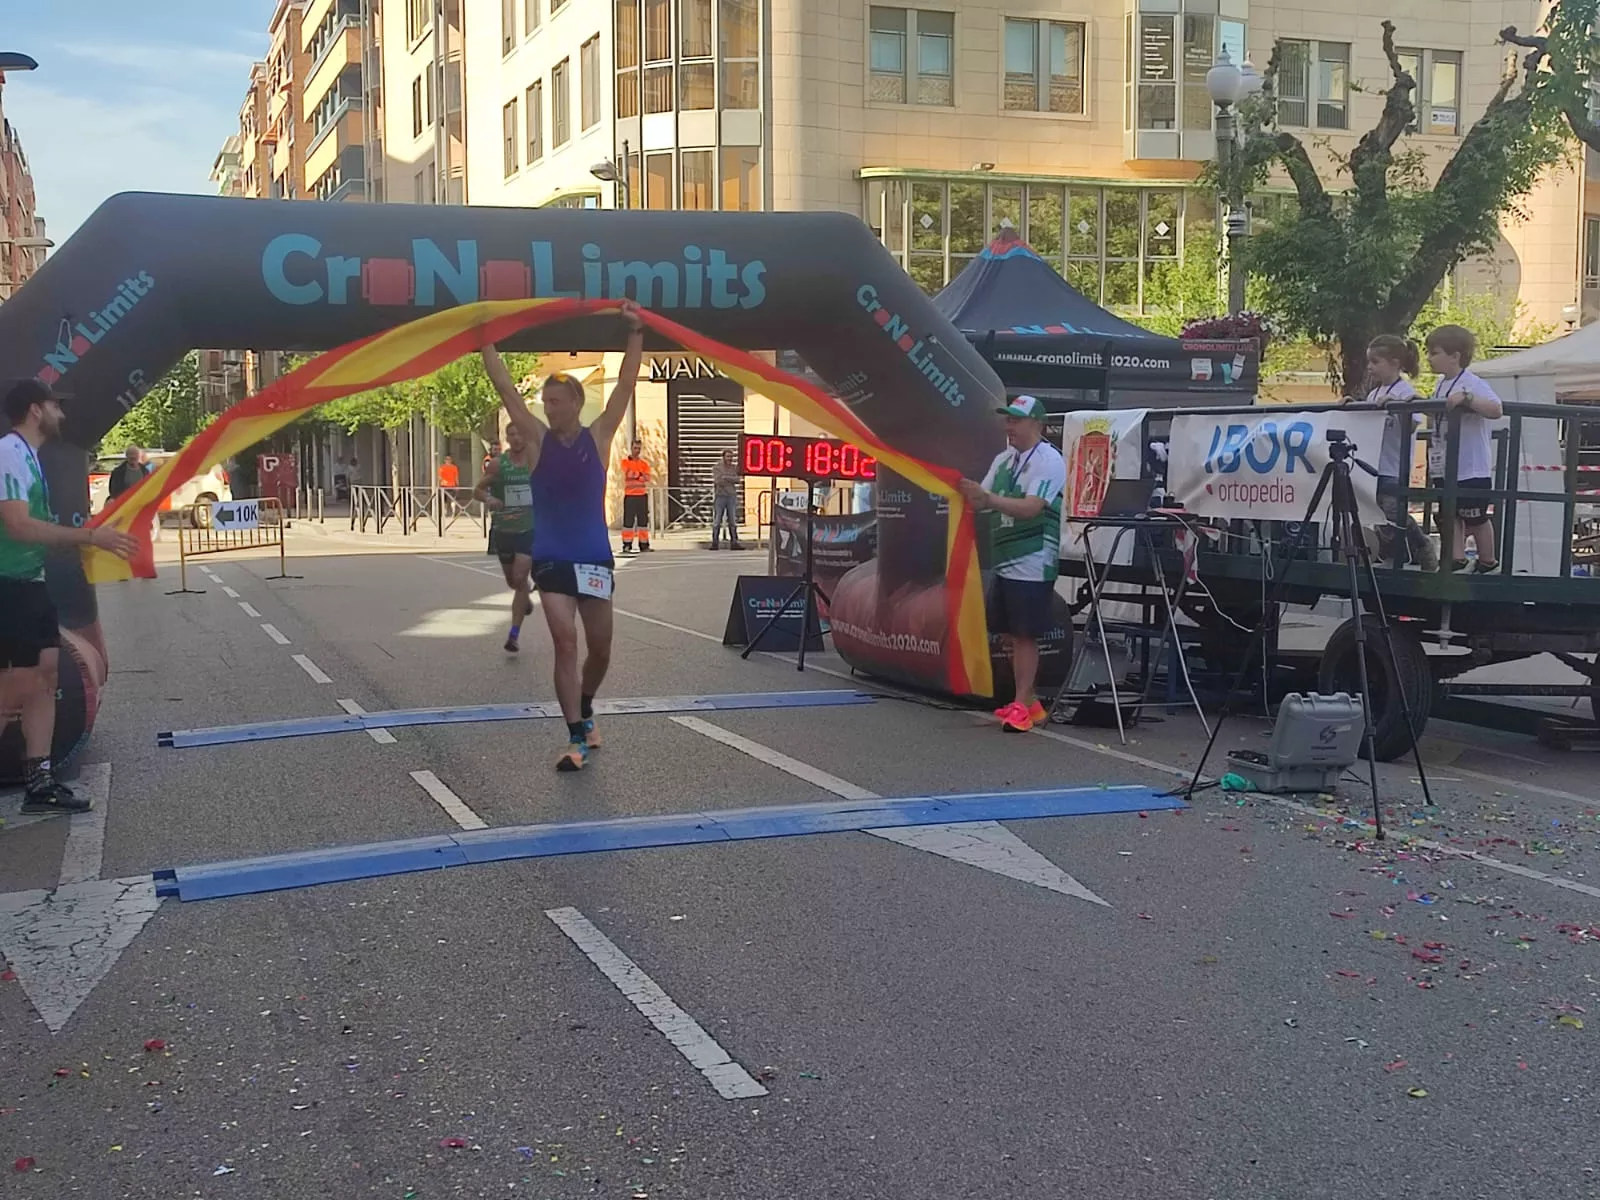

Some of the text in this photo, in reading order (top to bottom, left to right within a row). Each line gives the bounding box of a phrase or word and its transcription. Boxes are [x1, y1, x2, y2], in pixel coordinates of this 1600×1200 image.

[1204, 421, 1317, 474] IBOR
[1218, 477, 1295, 509] ortopedia
[236, 504, 258, 523] 10K
